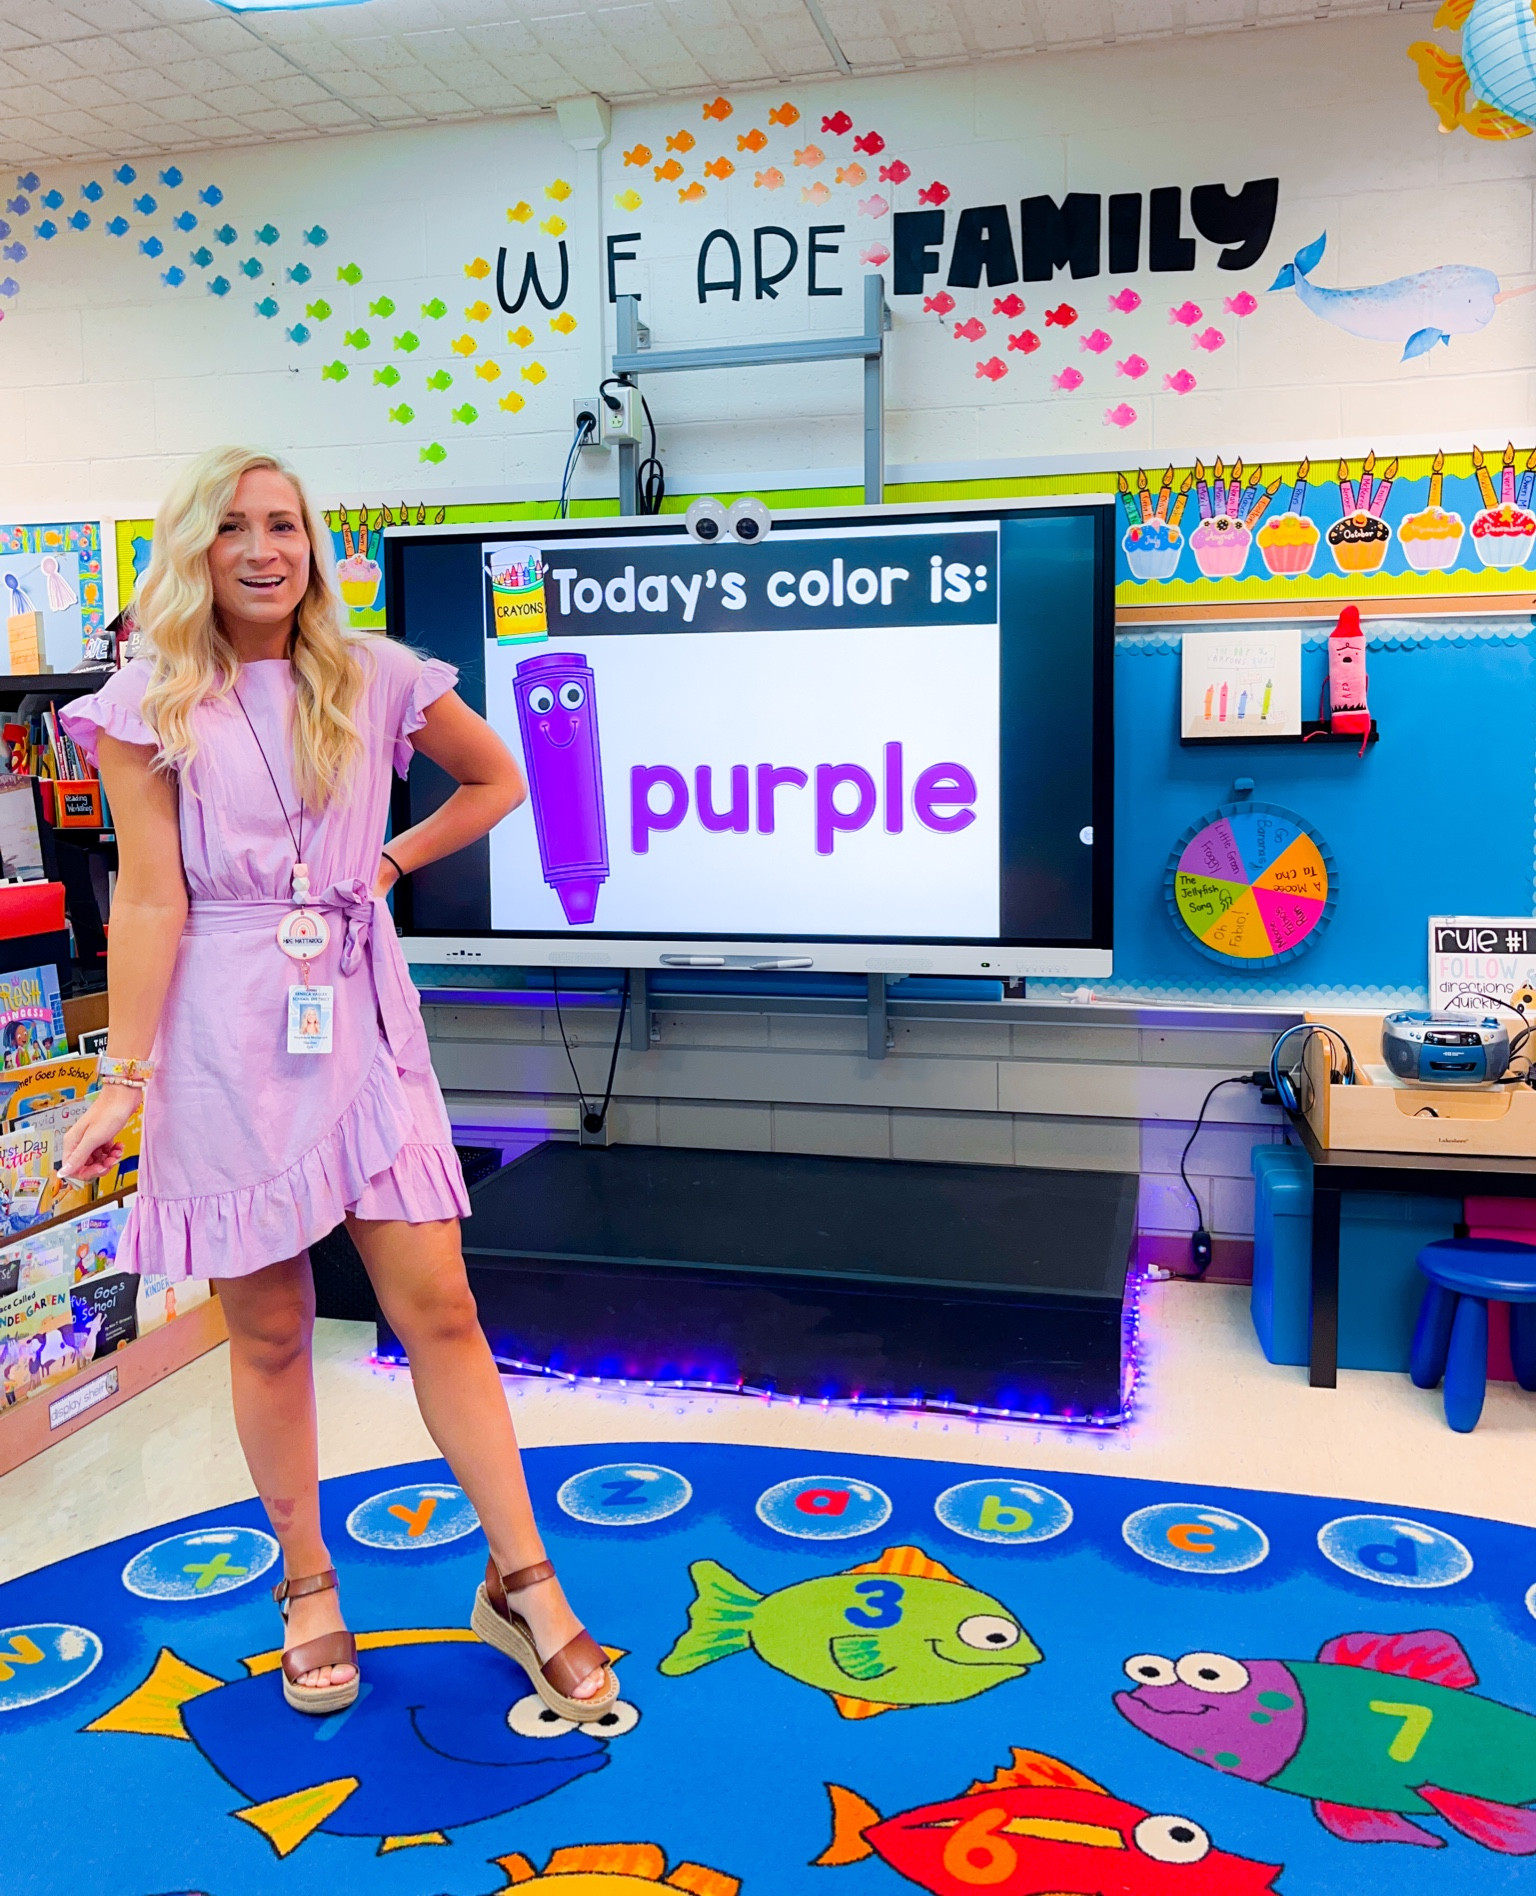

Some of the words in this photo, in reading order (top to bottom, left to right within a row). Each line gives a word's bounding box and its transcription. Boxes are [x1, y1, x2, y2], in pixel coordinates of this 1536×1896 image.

[697, 224, 846, 304] ARE
[893, 177, 1280, 296] FAMILY
[1343, 528, 1375, 539] October
[1483, 521, 1527, 533] December
[552, 565, 748, 622] Today's
[767, 558, 910, 608] color
[930, 554, 988, 604] is:
[497, 602, 544, 618] CRAYONS
[1342, 682, 1352, 699] RED
[630, 741, 977, 856] purple
[1179, 875, 1197, 885] The
[1181, 884, 1219, 899] Jellyfish
[1189, 902, 1214, 915] Song
[1436, 928, 1498, 953] rule
[1505, 929, 1528, 953] #1
[1439, 957, 1518, 980] FOLLOW
[1439, 981, 1514, 995] directions
[1451, 996, 1503, 1011] quickly
[35, 1067, 56, 1081] Goes
[58, 1066, 67, 1077] to
[67, 1066, 94, 1082] School
[24, 1140, 48, 1154] Day
[13, 1290, 36, 1307] Called
[94, 1282, 126, 1300] Goes
[82, 1296, 117, 1320] School
[51, 1396, 82, 1421] display
[84, 1379, 105, 1403] shelf
[795, 1488, 851, 1516] a
[978, 1494, 1034, 1535] b
[1357, 1536, 1419, 1577] d
[844, 1578, 906, 1631] 3
[1368, 1700, 1433, 1763] 7
[943, 1807, 1018, 1886] 6
